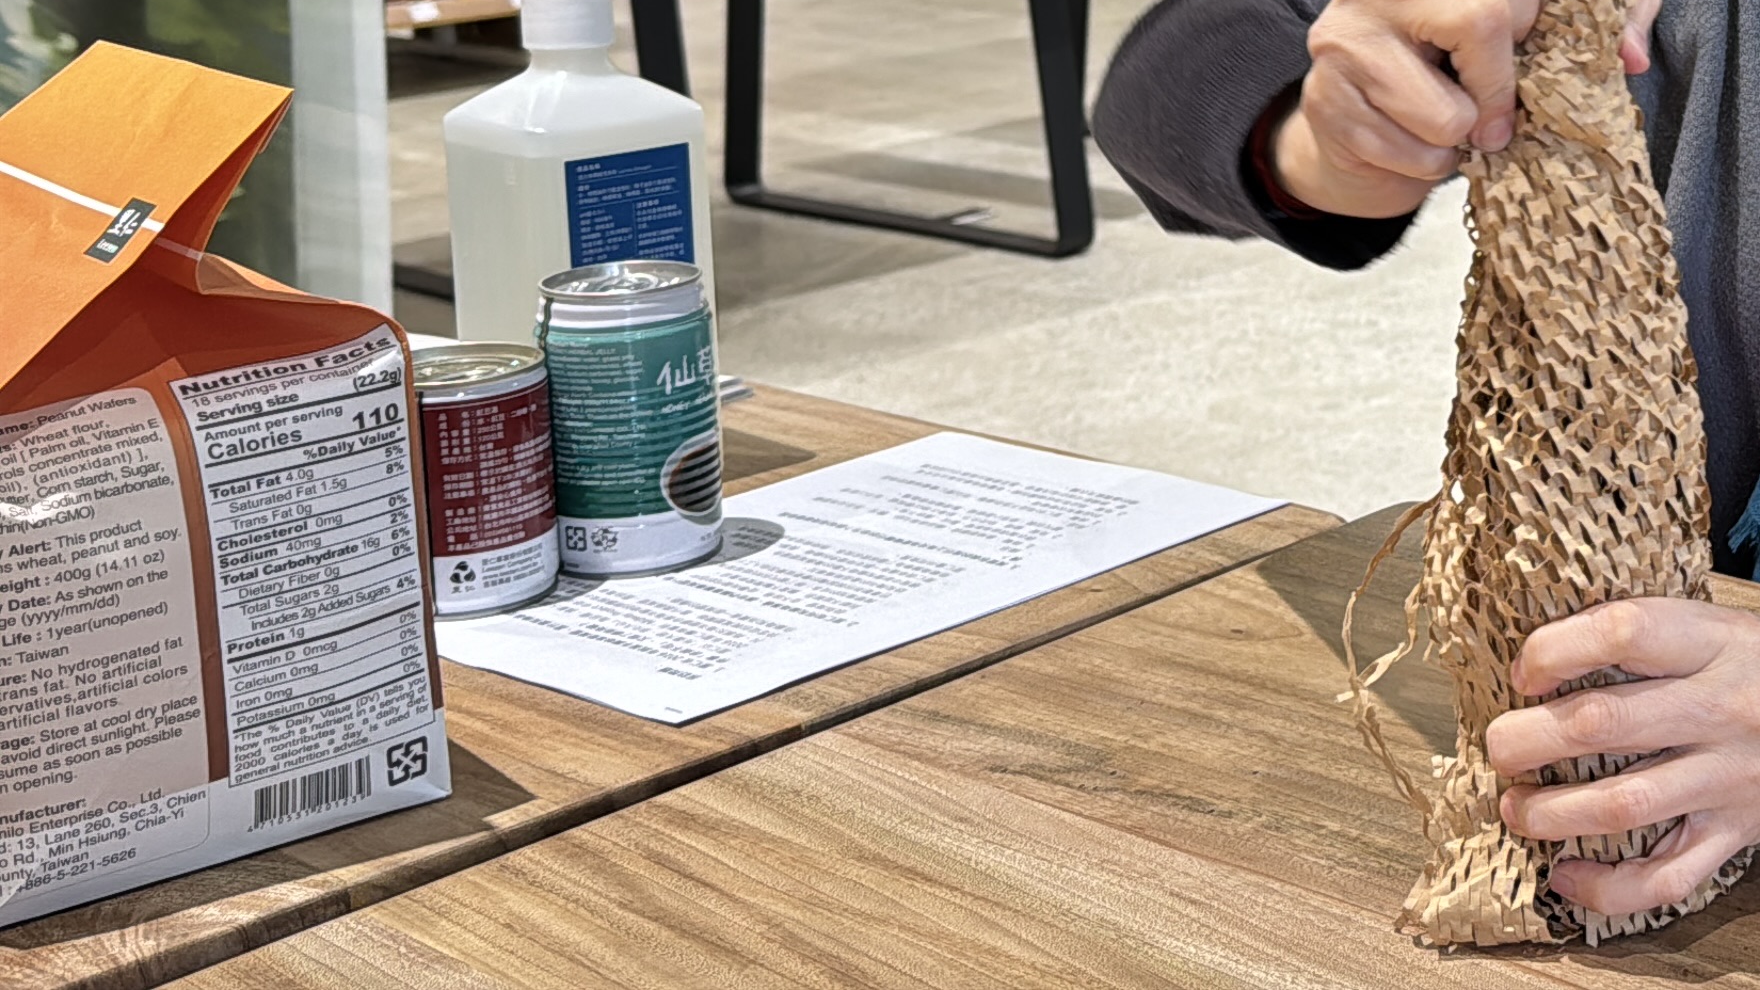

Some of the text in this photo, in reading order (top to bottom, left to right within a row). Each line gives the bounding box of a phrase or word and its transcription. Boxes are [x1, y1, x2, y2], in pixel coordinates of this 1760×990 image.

[179, 338, 391, 395] Nutrition Facts
[353, 370, 401, 391] (22.2g)
[192, 395, 210, 407] 18
[214, 383, 277, 402] servings
[282, 376, 304, 389] per
[38, 396, 136, 424] Peanut Wafers
[197, 395, 299, 421] Serving size
[352, 406, 399, 430] 110
[21, 425, 68, 446] Wheat
[30, 443, 65, 457] Palm
[93, 423, 144, 442] Vitamin
[205, 408, 342, 441] Amount per serving
[29, 430, 162, 472] concentrate mixed,
[208, 431, 302, 458] Calories
[385, 444, 403, 457] 5%
[33, 451, 131, 487] (antioxidant)
[37, 461, 164, 498] Corn starch, Sugar,
[386, 460, 404, 474] 8%
[42, 493, 91, 511] Sodium
[94, 474, 174, 499] bicarbonate,
[210, 469, 314, 499] Total Fat 4.0g
[230, 480, 347, 513] Saturated Fat 1.5g
[388, 494, 407, 507] 0%
[231, 505, 312, 531] Trans Fat 0g
[390, 510, 408, 523] 2%
[9, 519, 142, 556] Alert: This product
[218, 515, 342, 551] Cholesterol 0mg
[392, 526, 410, 539] 6%
[18, 529, 182, 570] wheat, peanut and soy.
[220, 536, 321, 568] Sodium 40mg
[220, 537, 380, 585] Total Carbohydrate 16g
[392, 542, 411, 556] 0%
[54, 568, 91, 582] 400g
[143, 548, 165, 563] oz)
[9, 570, 168, 610] Date: As shown the
[239, 567, 339, 598] Dietary Fiber 0g
[240, 585, 339, 616] Total Sugars 2g
[251, 575, 415, 630] Includes 2g Added Sugars 4%
[400, 609, 416, 622] 0%
[2, 634, 31, 646] Life
[228, 627, 304, 653] Protein 1g
[400, 626, 417, 639] 0%
[17, 646, 69, 663] Taiwan
[32, 636, 183, 679] No hydrogenated fat
[233, 640, 337, 674] Vitamin 0mcg
[401, 642, 418, 655] 0%
[76, 673, 97, 685] No
[102, 656, 162, 678] artificial
[143, 667, 188, 685] colors
[235, 664, 318, 691] Calcium 0mg
[403, 659, 420, 672] 0%
[66, 699, 118, 718] flavors
[236, 687, 292, 708] Iron 0mg
[237, 692, 335, 725] Potassium 0mg
[40, 696, 197, 741] Store cool dry place
[0, 709, 201, 762] avoid direct sunlight. Please
[66, 729, 182, 765] soon possible
[235, 735, 371, 783] general nutrition advice.
[13, 770, 77, 791] opening.
[17, 791, 206, 850] 13, Lane 260, Sec.3, Chien
[30, 808, 103, 831] Enterprise
[140, 788, 164, 802] Ltd.
[49, 842, 73, 856] Min
[135, 808, 184, 831] Chia-Yi
[41, 852, 89, 871] Taiwan
